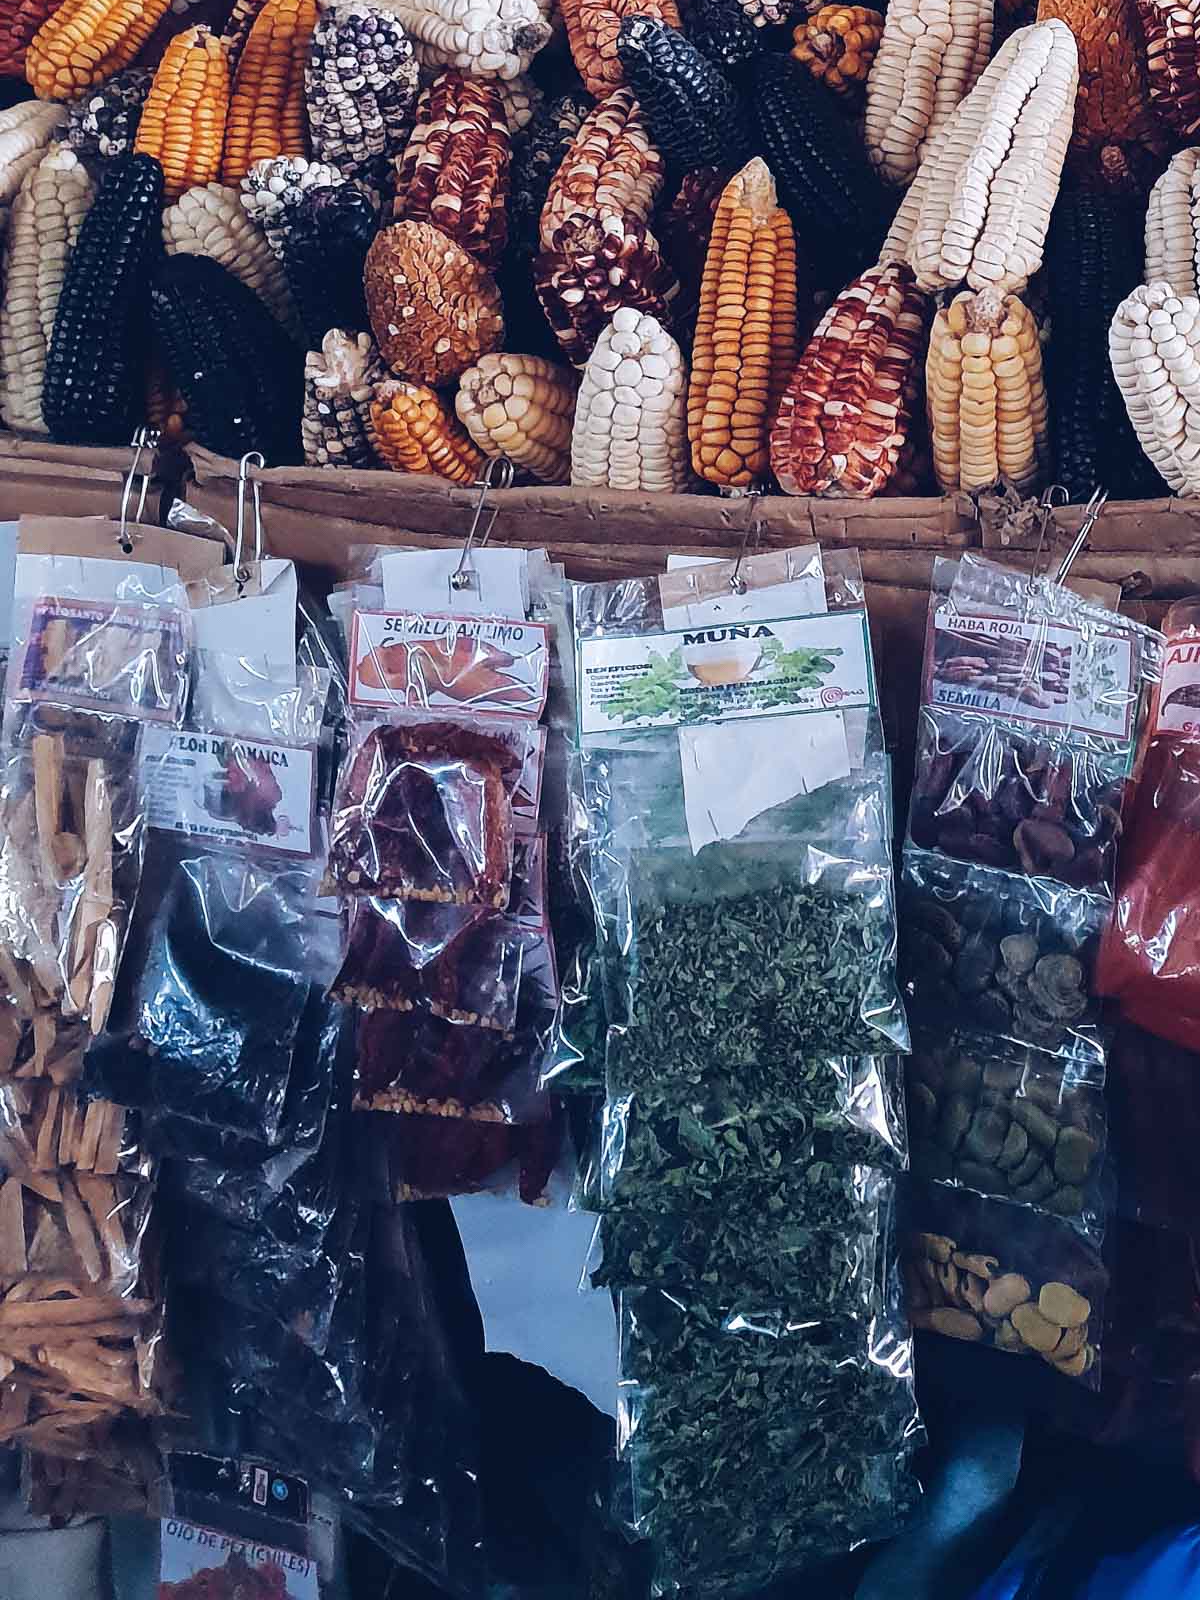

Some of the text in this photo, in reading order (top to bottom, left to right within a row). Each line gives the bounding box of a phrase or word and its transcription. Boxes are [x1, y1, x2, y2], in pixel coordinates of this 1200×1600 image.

[383, 617, 453, 636] SEMILLA
[683, 625, 775, 647] MUÑA
[948, 617, 1024, 636] HABA ROJA
[1167, 647, 1200, 666] AJI
[936, 689, 1001, 710] SEMILLA
[166, 1520, 194, 1542] OJO
[197, 1532, 218, 1549] DE
